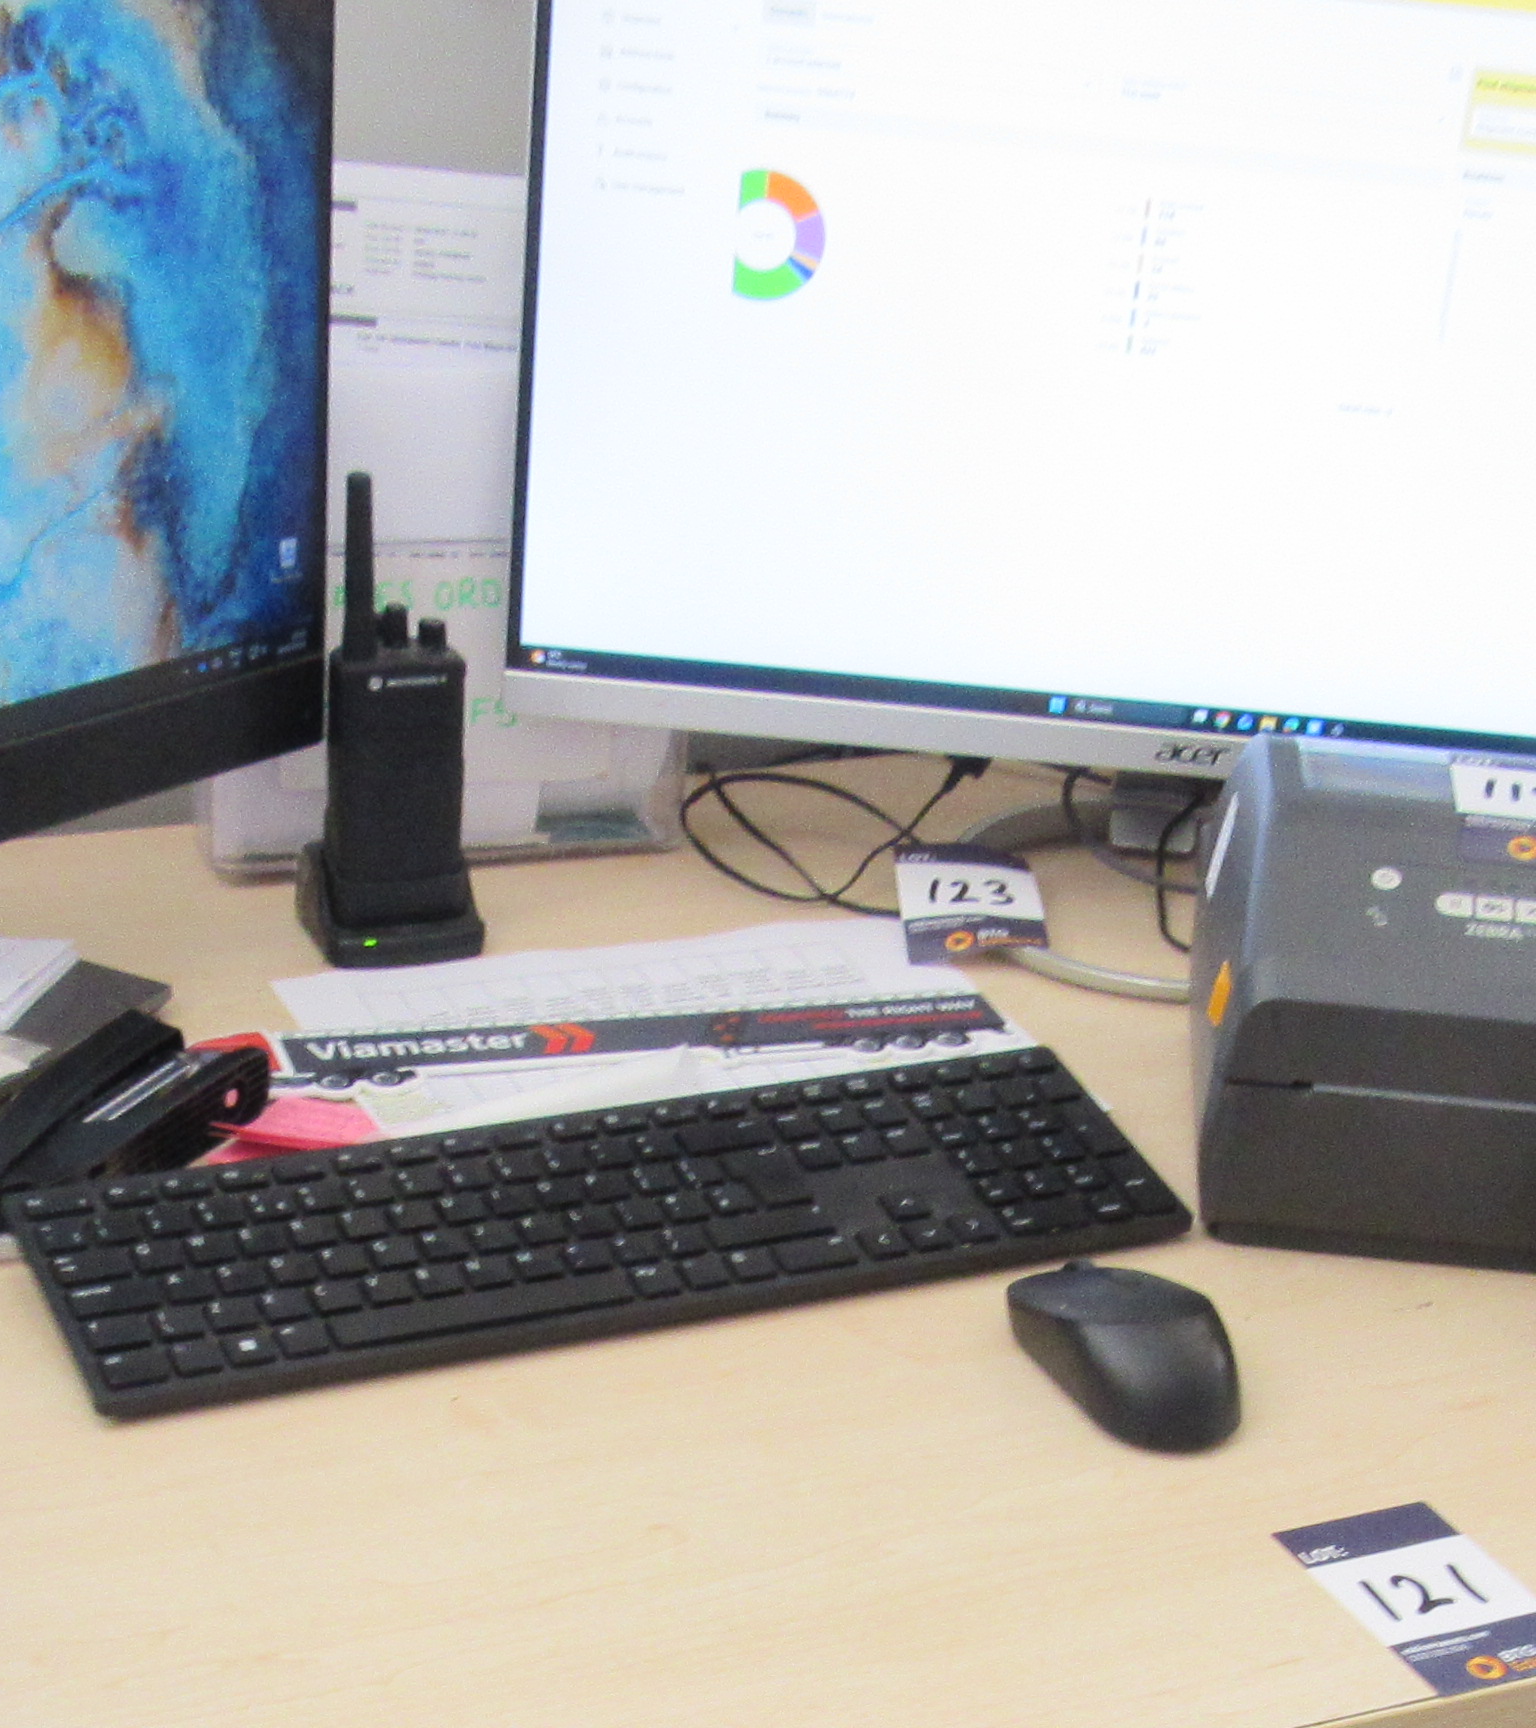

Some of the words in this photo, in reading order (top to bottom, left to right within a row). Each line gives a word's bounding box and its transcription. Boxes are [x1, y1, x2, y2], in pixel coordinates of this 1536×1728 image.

[1154, 742, 1232, 767] acer
[929, 878, 1016, 906] 123
[305, 1031, 530, 1062] Viamaster
[1359, 1563, 1488, 1621] 121
